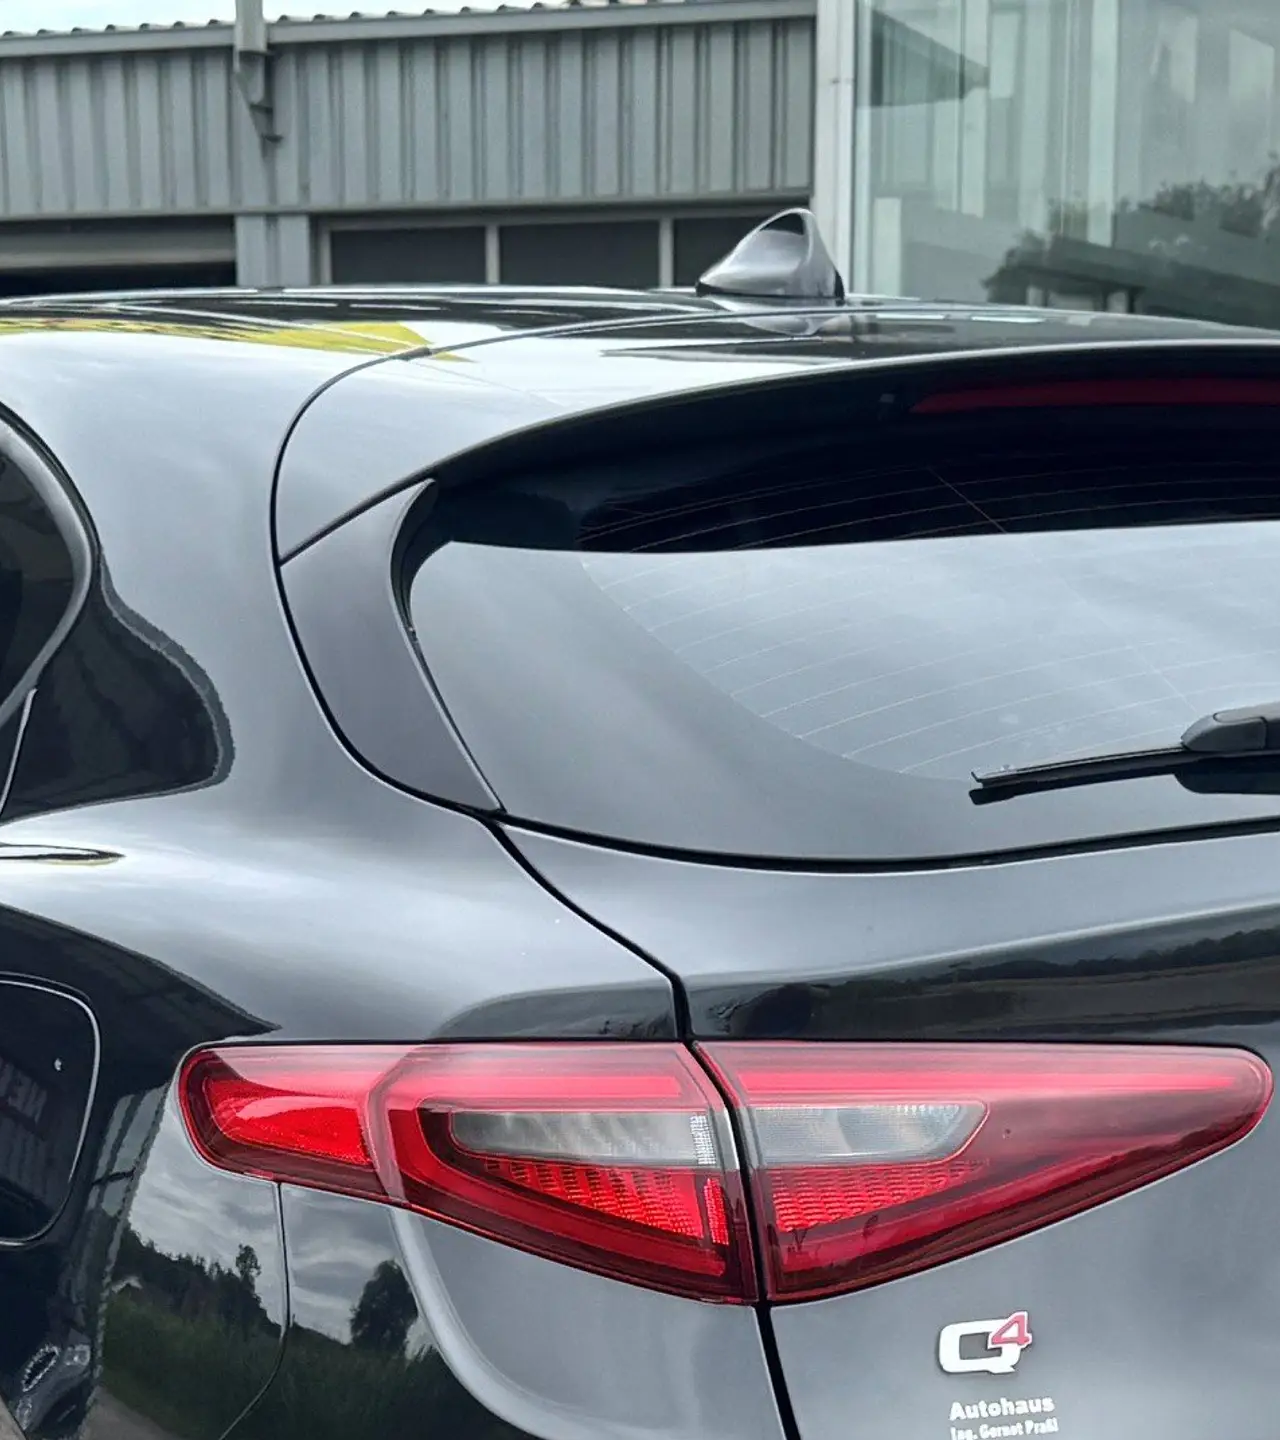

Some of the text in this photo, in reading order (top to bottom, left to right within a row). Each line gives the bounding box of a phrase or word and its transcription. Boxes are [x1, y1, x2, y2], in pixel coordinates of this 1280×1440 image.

[938, 1310, 1033, 1375] Q4
[949, 1397, 1056, 1421] Autohaus
[979, 1421, 1024, 1440] Gernot
